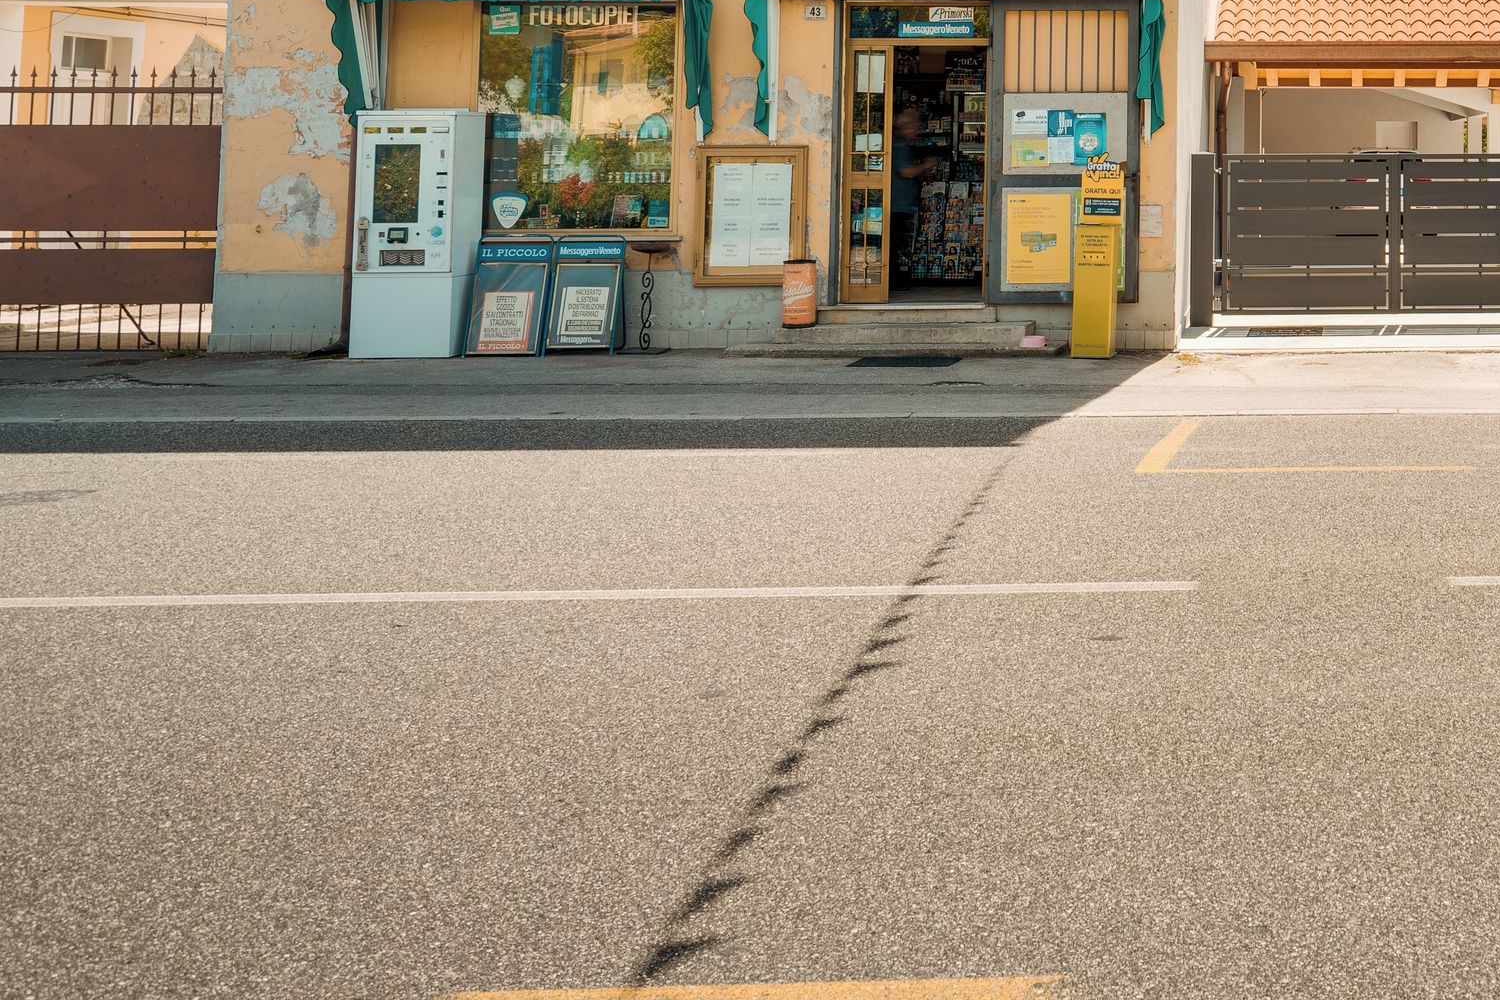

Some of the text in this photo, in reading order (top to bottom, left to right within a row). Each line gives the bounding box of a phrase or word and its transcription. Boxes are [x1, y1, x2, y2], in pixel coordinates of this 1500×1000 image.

[529, 5, 634, 26] FOTOCOPIE
[809, 7, 821, 17] 43
[940, 7, 973, 19] Primorski
[902, 23, 970, 35] MessaggeroVeneto
[1087, 162, 1117, 171] Gratta
[482, 249, 547, 257] IL PICCOLO
[560, 246, 621, 256] MessaggeroVeneto
[496, 295, 518, 303] EFFETTO
[489, 319, 518, 327] STAGIONALI
